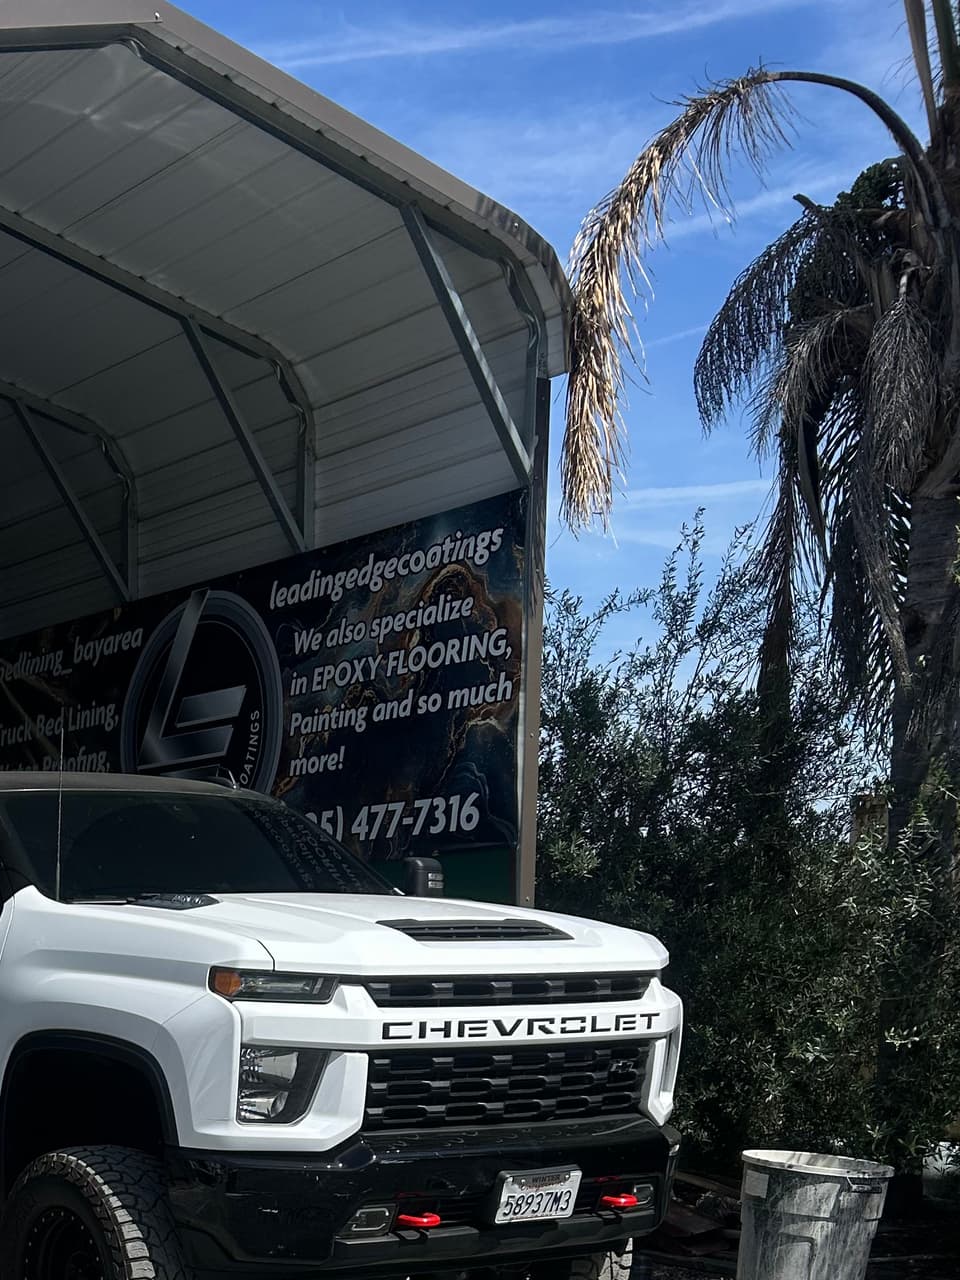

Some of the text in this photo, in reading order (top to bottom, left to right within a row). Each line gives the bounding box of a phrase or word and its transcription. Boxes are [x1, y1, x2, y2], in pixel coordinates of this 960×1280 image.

[269, 527, 504, 610] leadingedgecoatings
[294, 594, 474, 655] We also specialize
[290, 628, 513, 696] in EPOXY FLOORING,
[37, 705, 65, 737] Bed
[69, 699, 119, 732] Lining,
[290, 672, 513, 737] Painting and so much
[290, 746, 345, 777] more!
[351, 791, 480, 841] 477-7316
[381, 1012, 660, 1040] CHEVROLET
[503, 1190, 572, 1216] 58937M3
